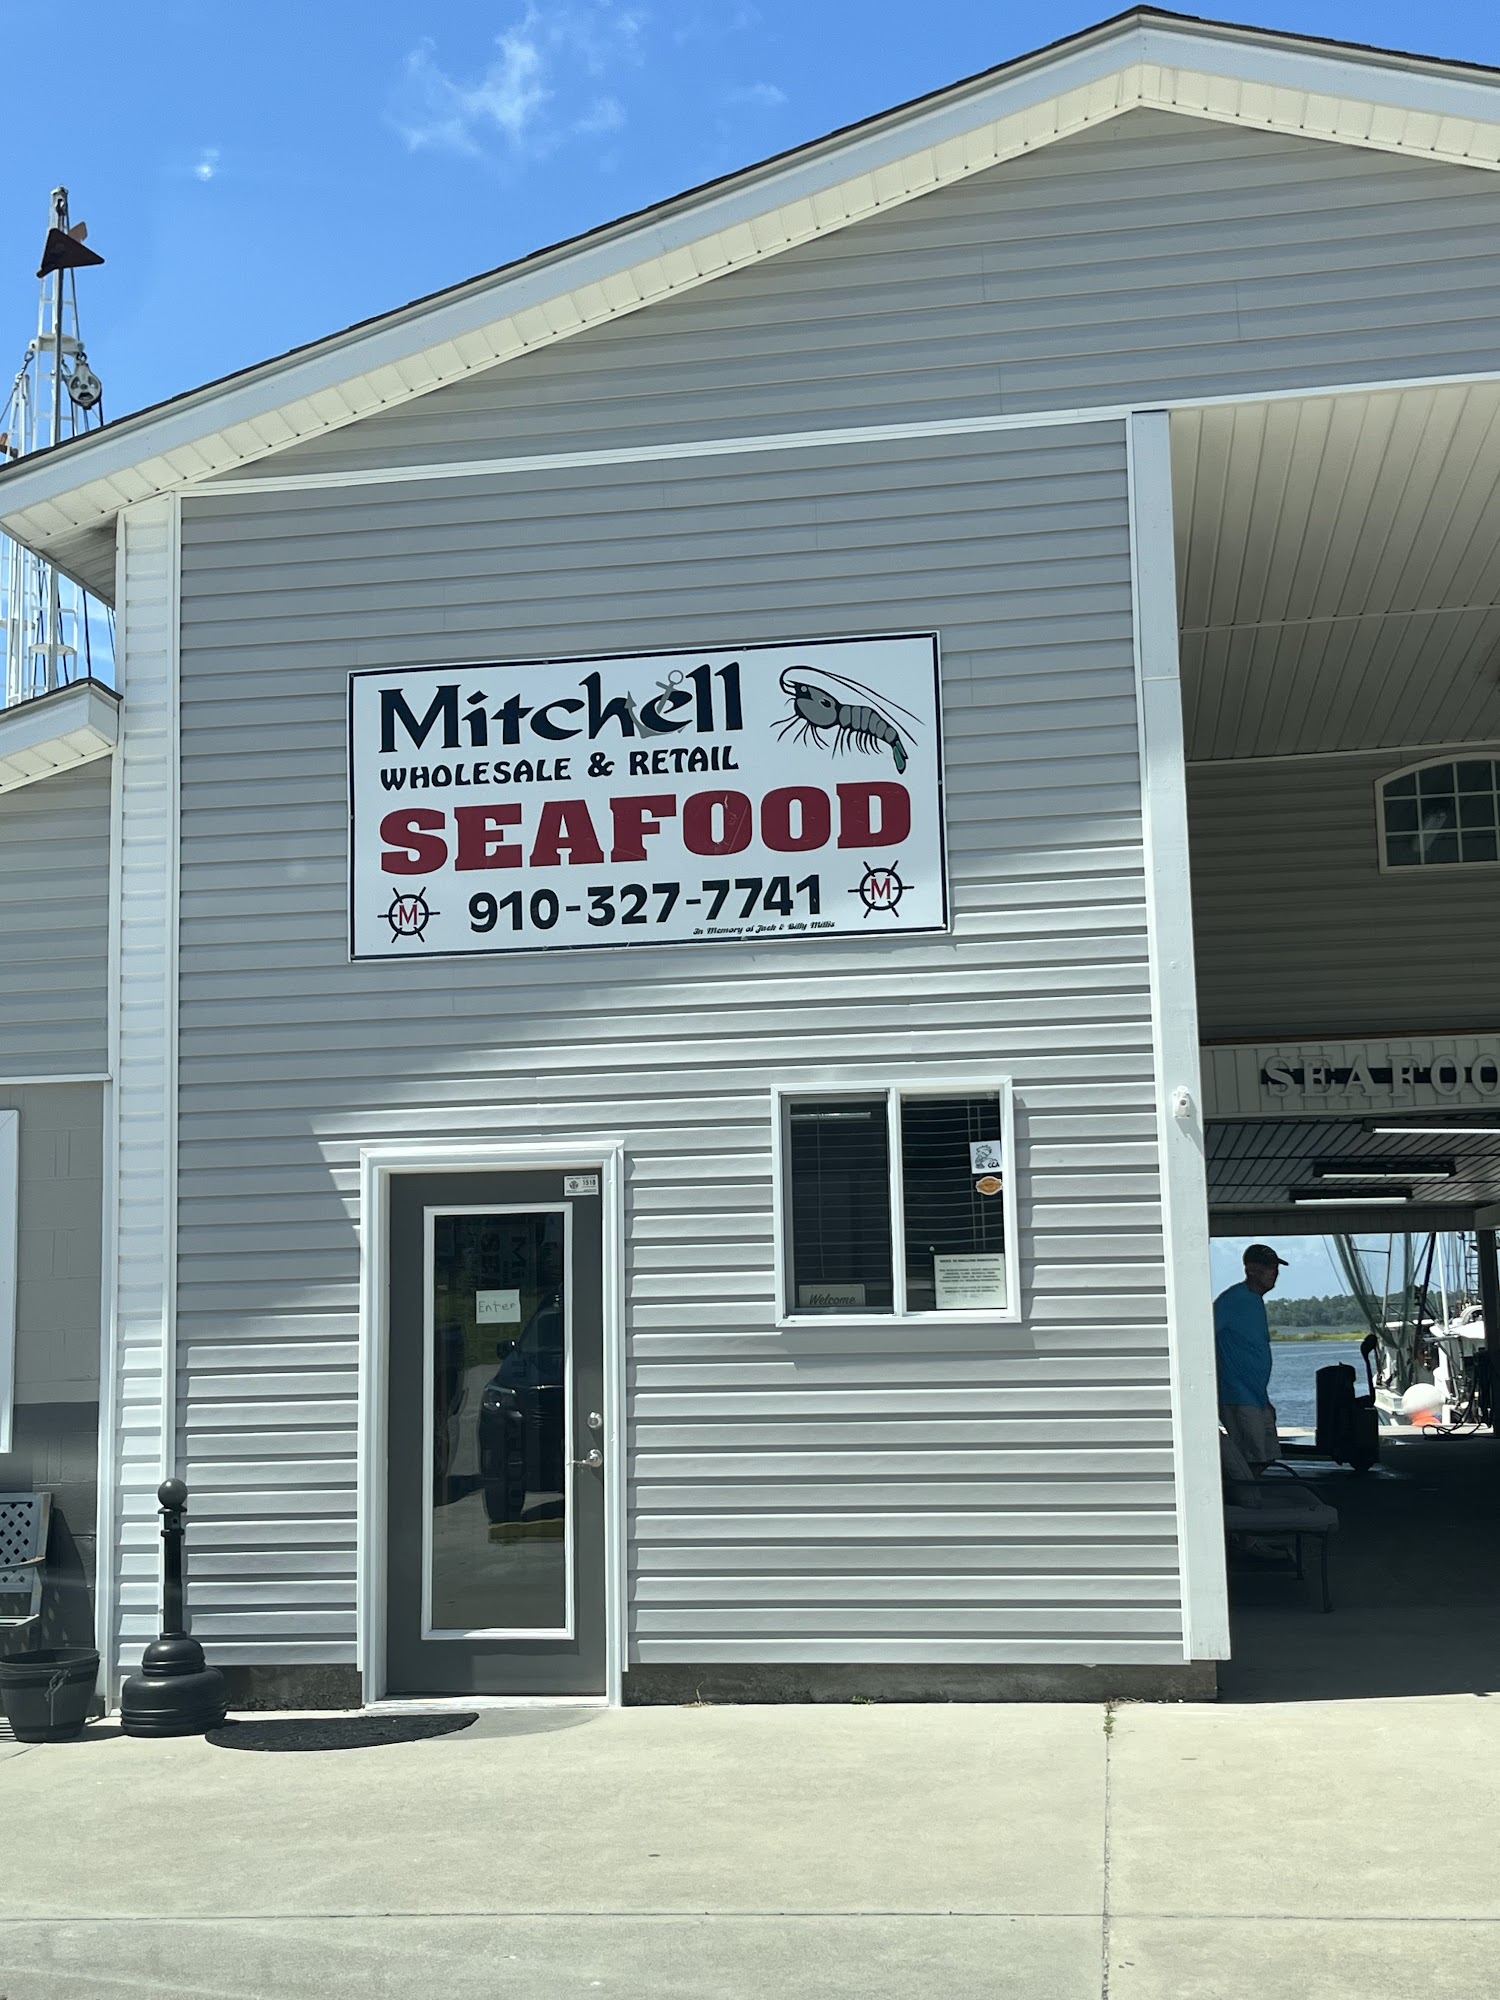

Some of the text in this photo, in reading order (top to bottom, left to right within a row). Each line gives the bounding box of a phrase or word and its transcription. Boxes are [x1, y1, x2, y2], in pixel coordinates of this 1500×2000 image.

[378, 661, 744, 754] Mitchell
[380, 745, 740, 791] WHOLESALE & RETAIL
[379, 781, 912, 876] SEAFOOD
[870, 877, 892, 901] M
[398, 903, 418, 926] M
[468, 874, 822, 933] 910-327-7741
[692, 927, 704, 935] In
[706, 926, 744, 935] Memory
[745, 924, 755, 933] of
[755, 924, 777, 934] Jack
[787, 922, 808, 931] Billy
[478, 1300, 516, 1313] Enter
[809, 1292, 857, 1306] Welcome
